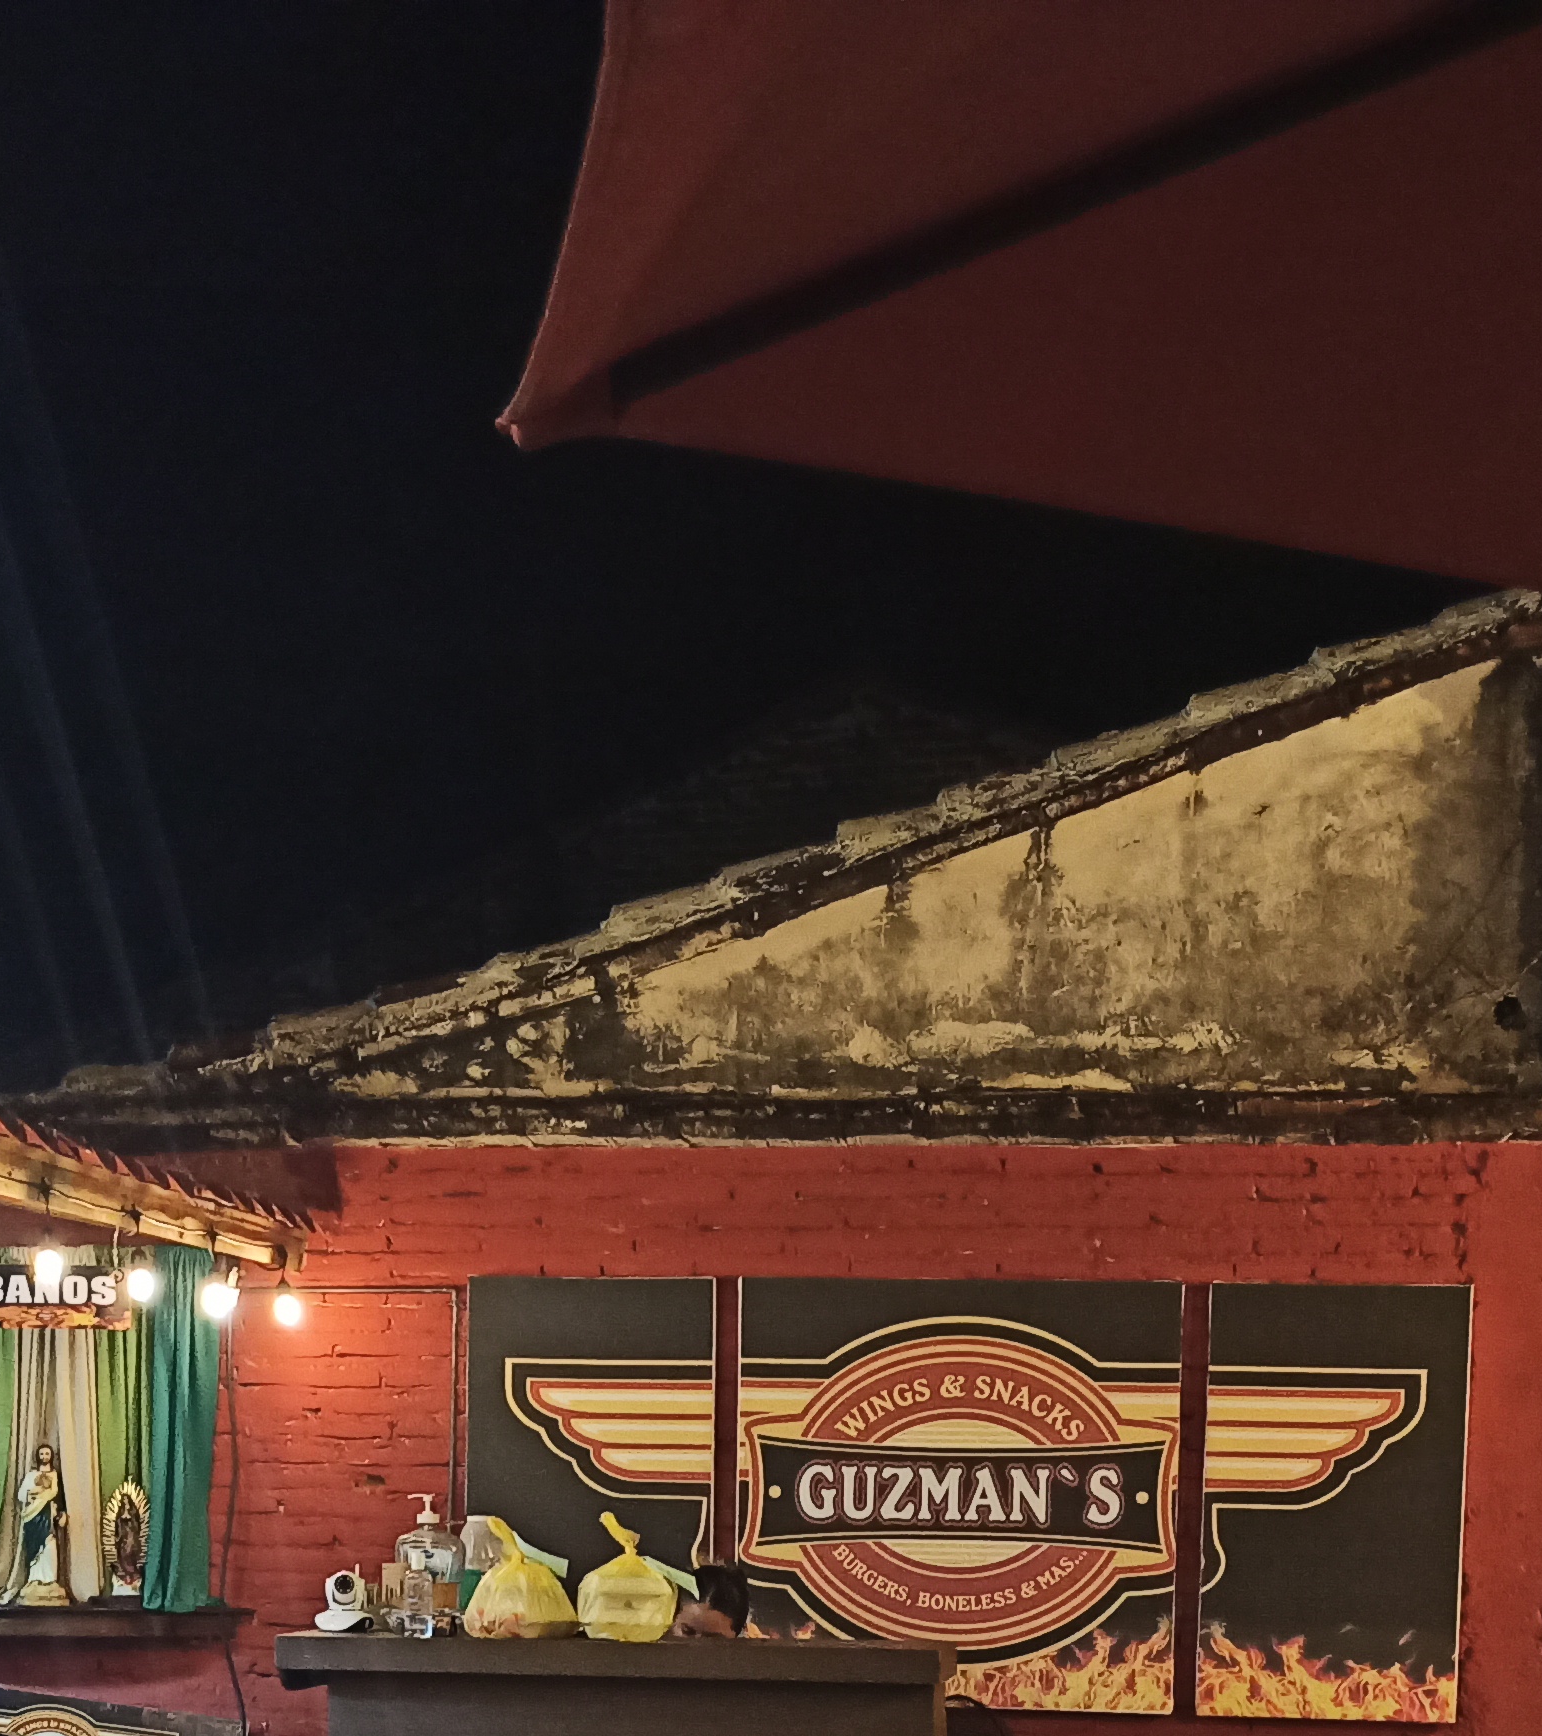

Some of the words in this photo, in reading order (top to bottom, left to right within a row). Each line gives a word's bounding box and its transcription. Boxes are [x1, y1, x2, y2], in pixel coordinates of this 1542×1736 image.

[834, 1378, 932, 1439] WINGS
[940, 1374, 966, 1398] &
[973, 1375, 1085, 1441] SNACKS
[831, 1545, 912, 1606] BURGERS,
[916, 1588, 1017, 1612] BONELESS
[1020, 1582, 1039, 1599] &
